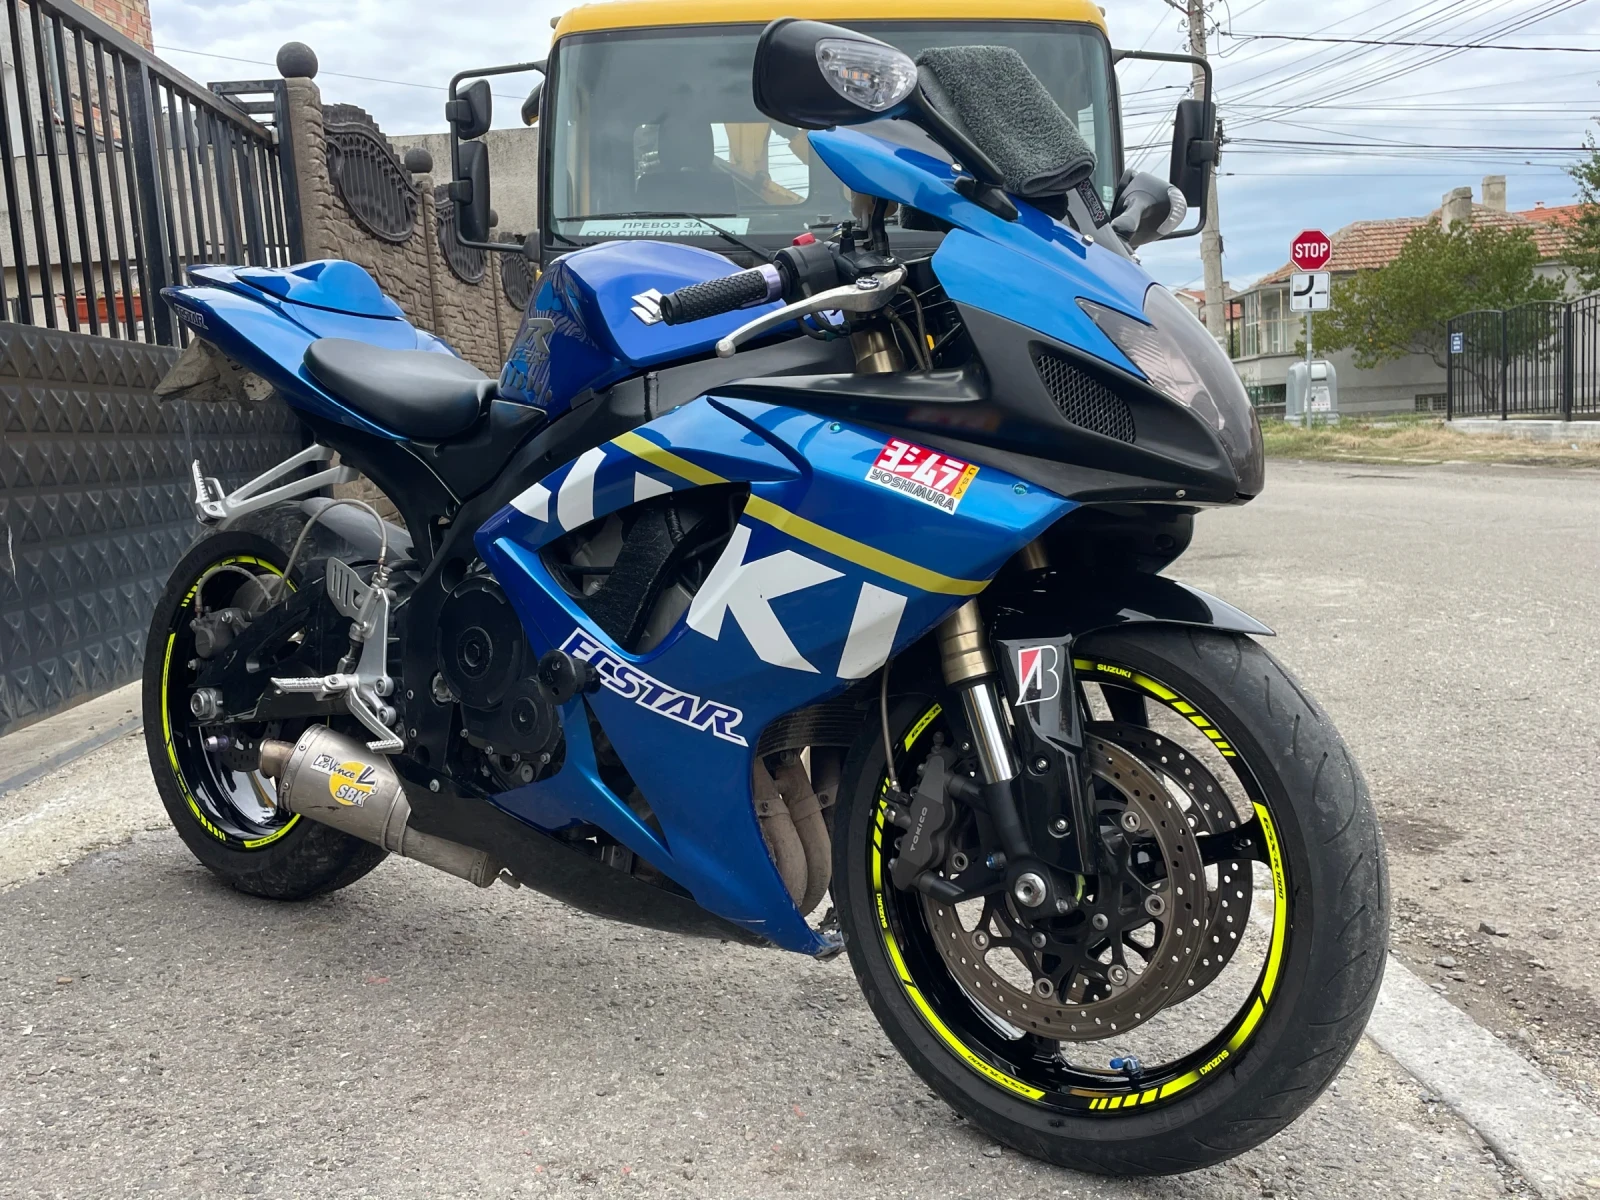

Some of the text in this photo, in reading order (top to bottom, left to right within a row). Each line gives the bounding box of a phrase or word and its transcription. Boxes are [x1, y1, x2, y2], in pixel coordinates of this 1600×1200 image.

[1294, 242, 1329, 258] STOP
[876, 440, 965, 490] ヨシムラ
[869, 468, 956, 512] YOSHIMURA
[558, 626, 750, 748] ECSTAR
[1096, 662, 1132, 679] SUZUKI
[334, 783, 370, 807] SBK
[909, 806, 928, 852] TOKICO
[1262, 816, 1285, 900] GSX-R 1000
[876, 893, 888, 929] SUZUKI
[1199, 1049, 1230, 1075] SUZUKI
